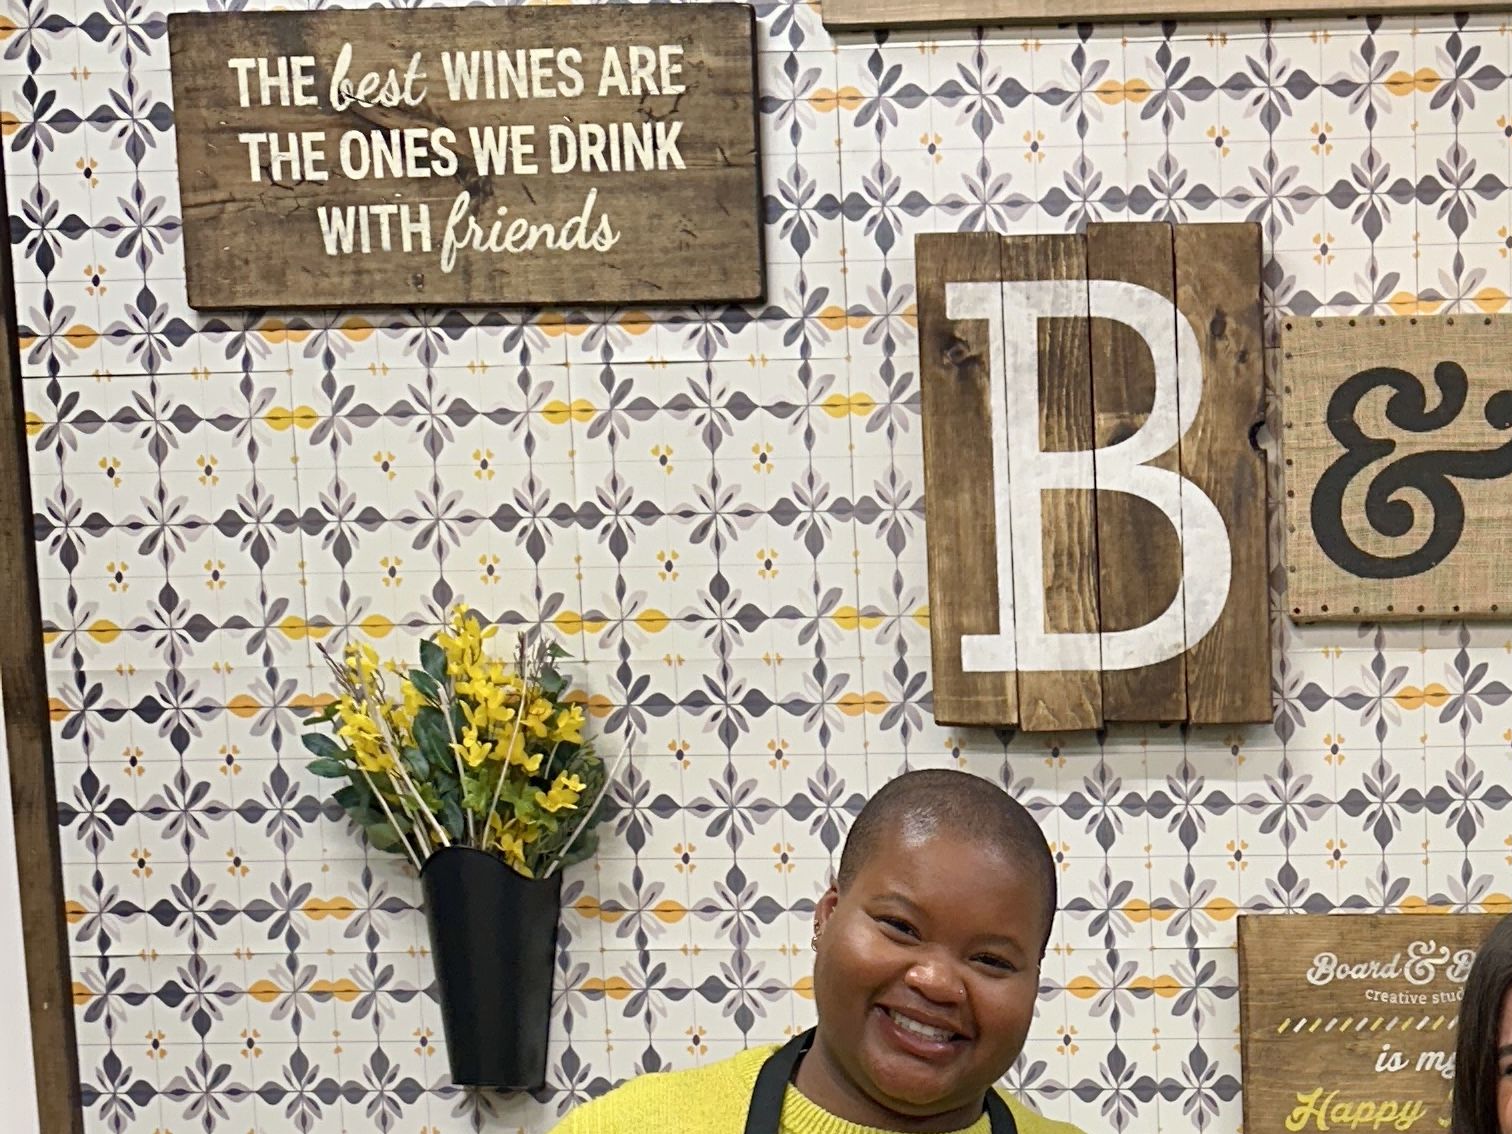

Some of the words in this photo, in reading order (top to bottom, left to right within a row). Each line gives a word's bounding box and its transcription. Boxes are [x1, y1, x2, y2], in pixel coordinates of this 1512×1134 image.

[228, 55, 319, 107] THE
[330, 42, 427, 112] best
[441, 48, 585, 101] WINES
[598, 45, 687, 97] ARE
[238, 131, 329, 182] THE
[339, 127, 459, 180] ONES
[468, 124, 539, 176] WE
[549, 121, 687, 174] DRINK
[317, 203, 432, 256] WITH
[440, 187, 621, 273] friends
[945, 279, 1232, 672] B
[1306, 952, 1402, 986] Board
[1403, 939, 1450, 986] &
[1365, 988, 1427, 1005] creative
[1431, 986, 1466, 1005] stud
[1375, 1043, 1410, 1072] is
[1285, 1086, 1428, 1132] Happy
